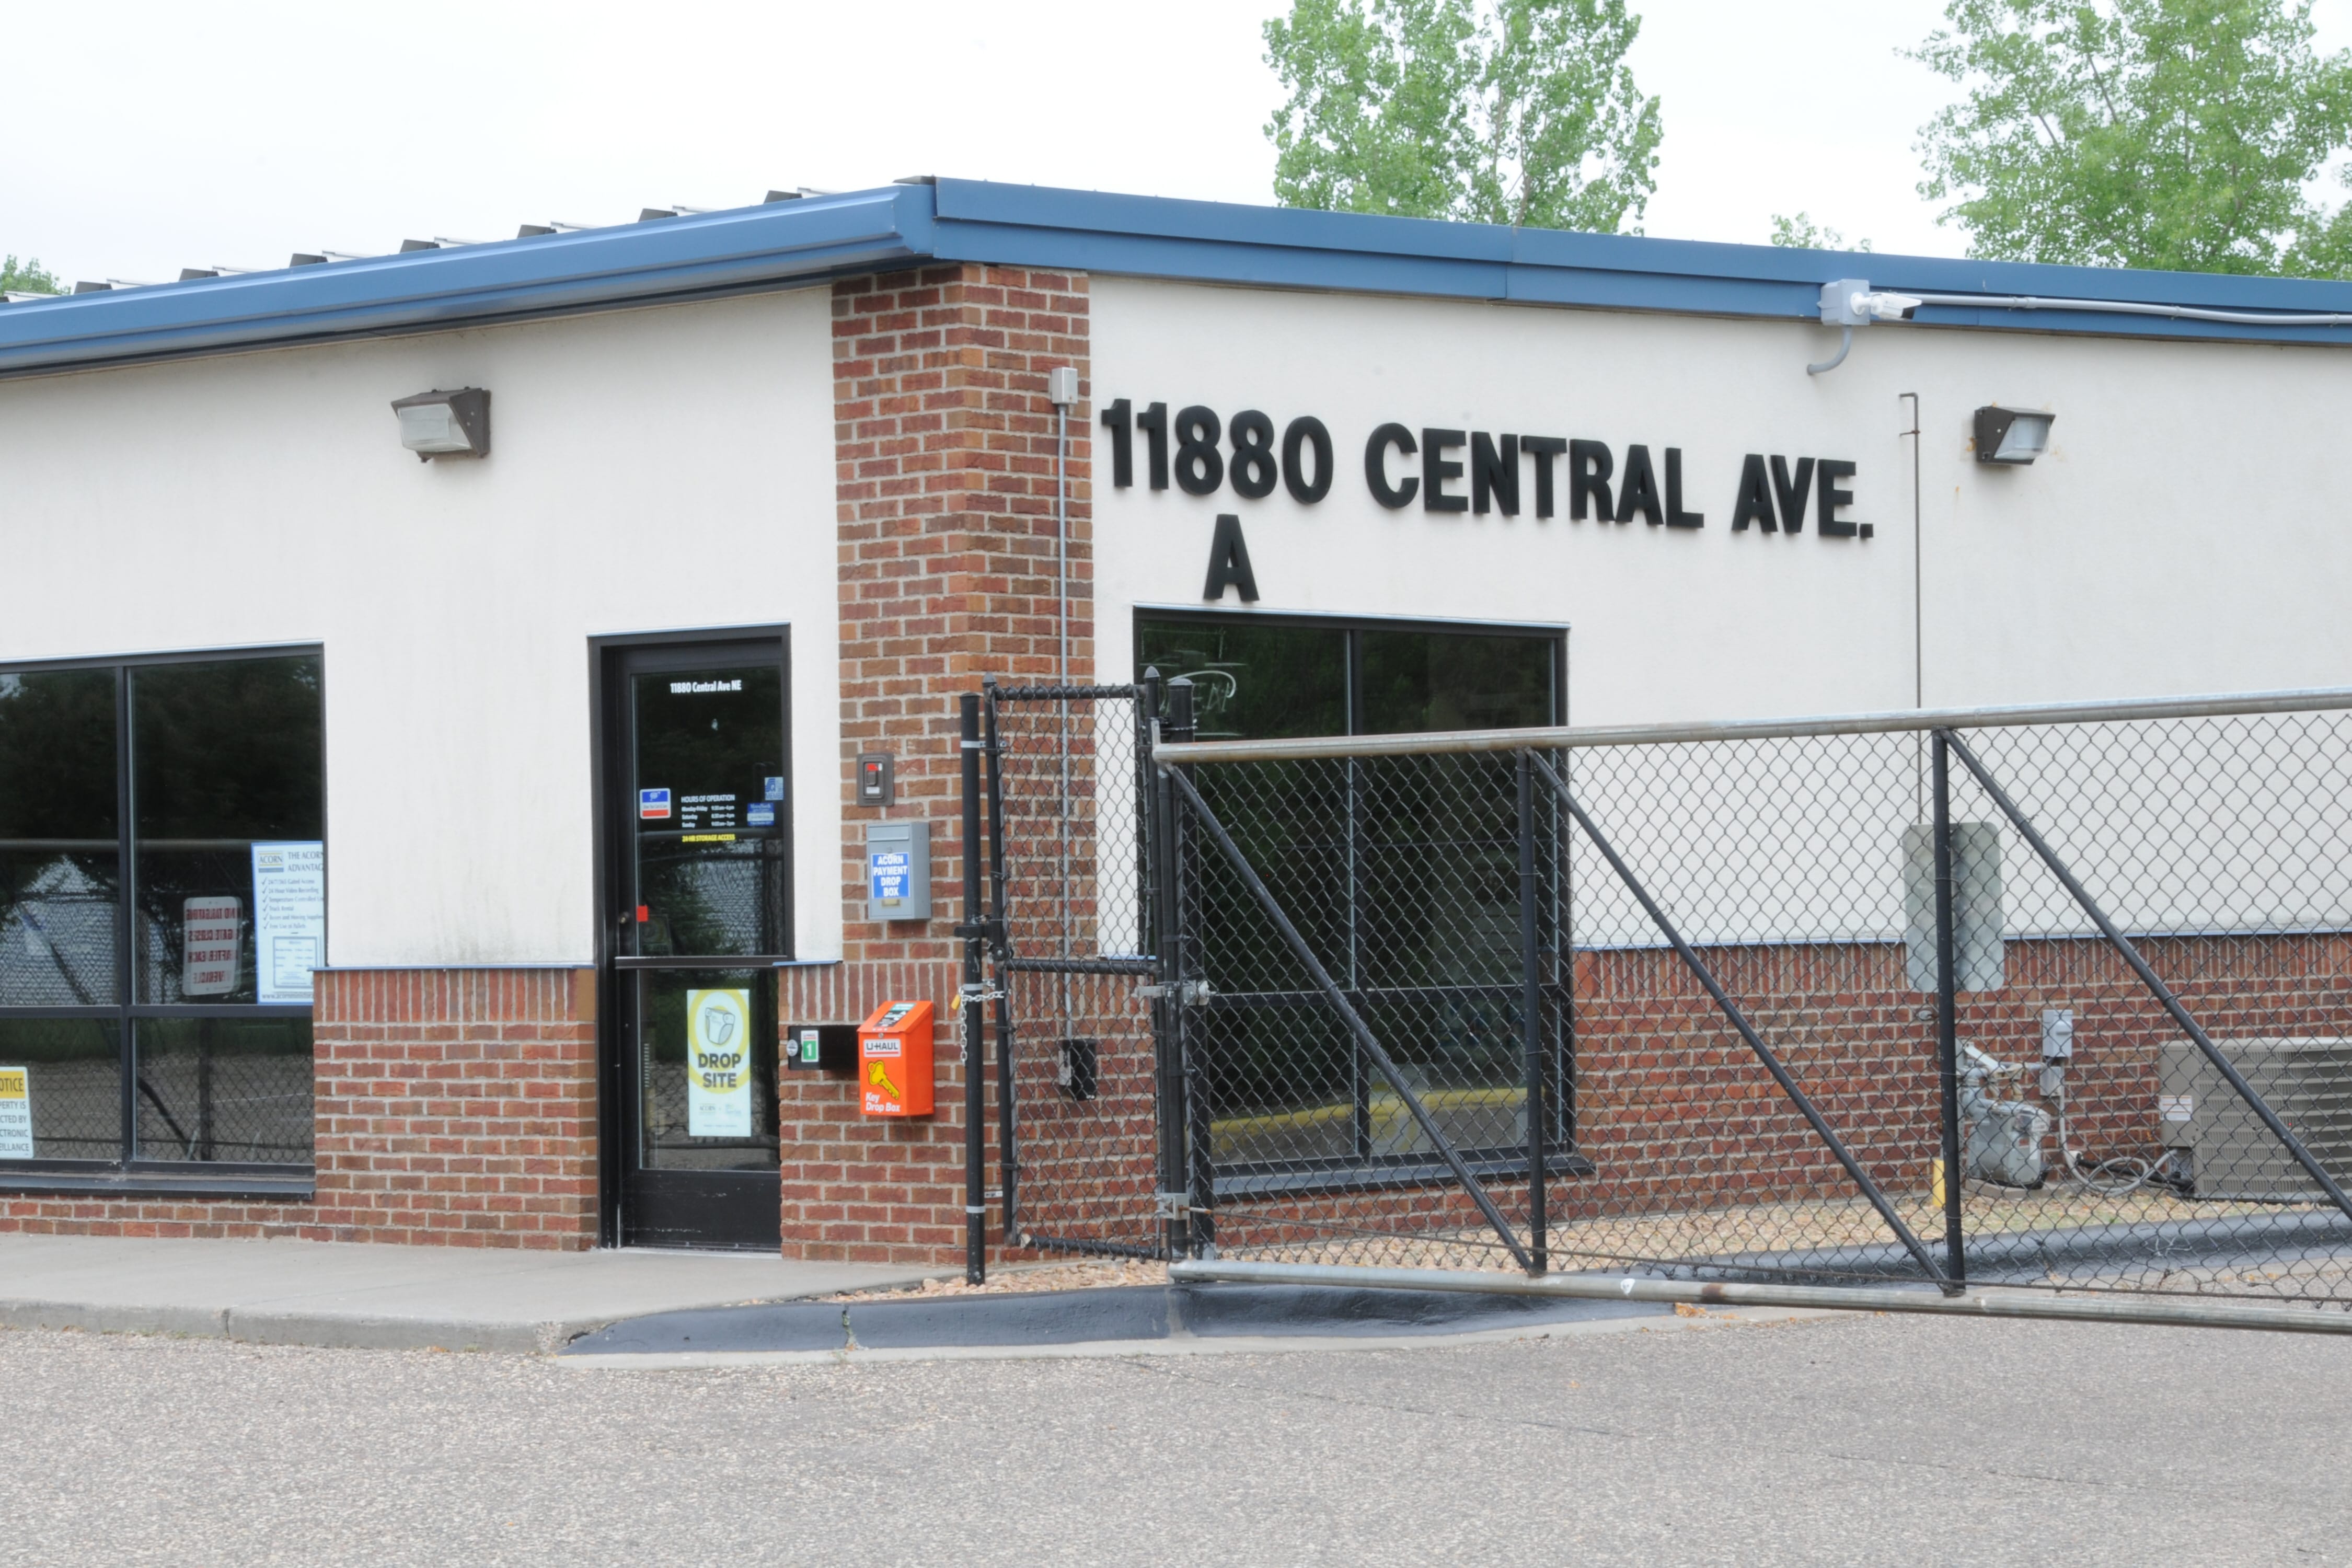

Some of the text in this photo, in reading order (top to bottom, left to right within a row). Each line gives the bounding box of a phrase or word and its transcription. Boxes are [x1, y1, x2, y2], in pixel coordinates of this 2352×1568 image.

[1101, 398, 1874, 539] 11880 CENTRAL AVE.
[1203, 513, 1260, 602] A
[670, 679, 742, 693] 11880 Central Ave NE
[259, 856, 283, 864] ACORN
[288, 851, 300, 860] THE
[878, 855, 903, 865] ACORN
[873, 866, 908, 876] PAYMENT
[881, 877, 901, 886] DROP
[884, 887, 898, 897] BOX
[806, 1043, 812, 1056] 1
[866, 1042, 898, 1050] U-HAUL
[698, 1053, 741, 1069] DROP
[702, 1072, 737, 1088] SITE
[866, 1092, 880, 1103] Key
[20, 1101, 26, 1109] IS
[866, 1102, 901, 1113] Drop Box
[18, 1115, 26, 1124] BY
